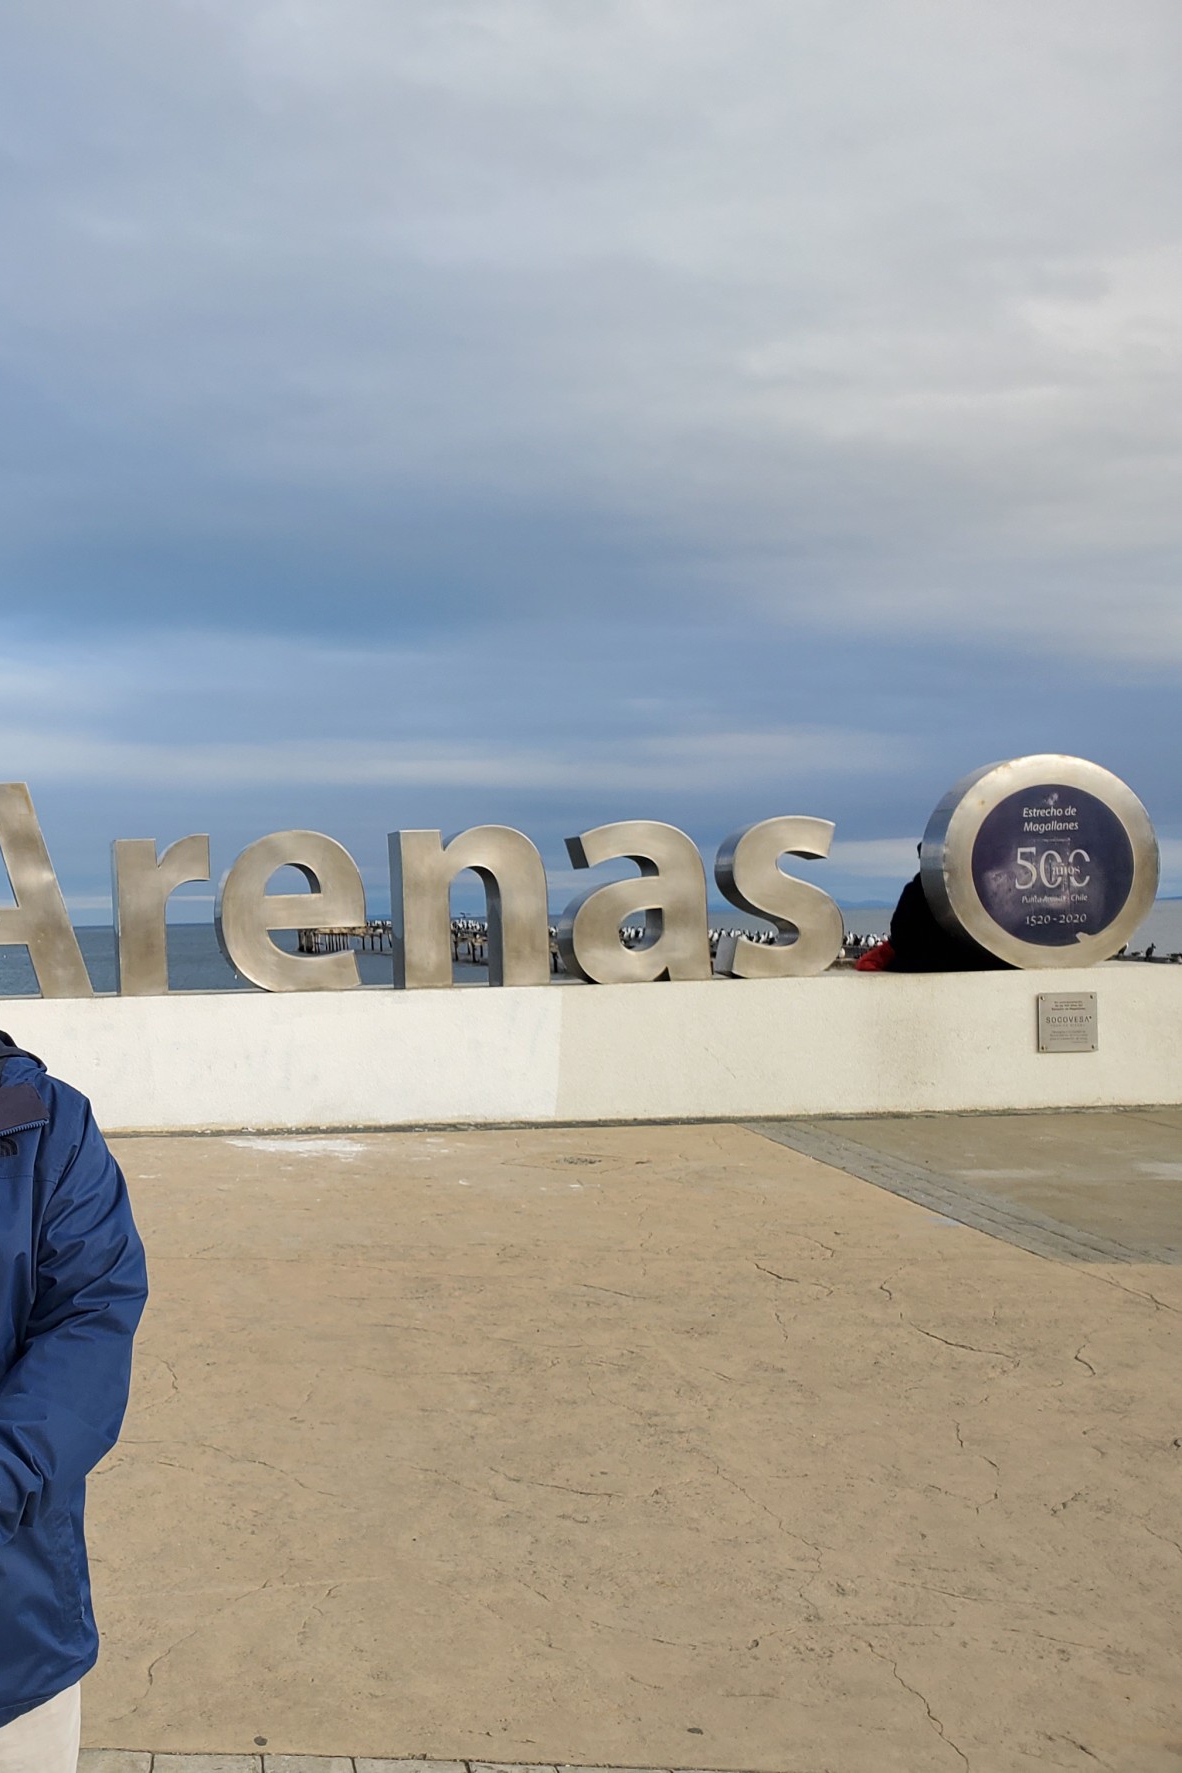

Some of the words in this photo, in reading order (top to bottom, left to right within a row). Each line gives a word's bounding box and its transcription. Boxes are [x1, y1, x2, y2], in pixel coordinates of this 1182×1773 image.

[1023, 806, 1063, 817] Estrecho
[1064, 805, 1077, 816] de
[1023, 820, 1079, 834] Magallanes
[1026, 914, 1051, 927] 1520
[1058, 913, 1087, 924] 2020
